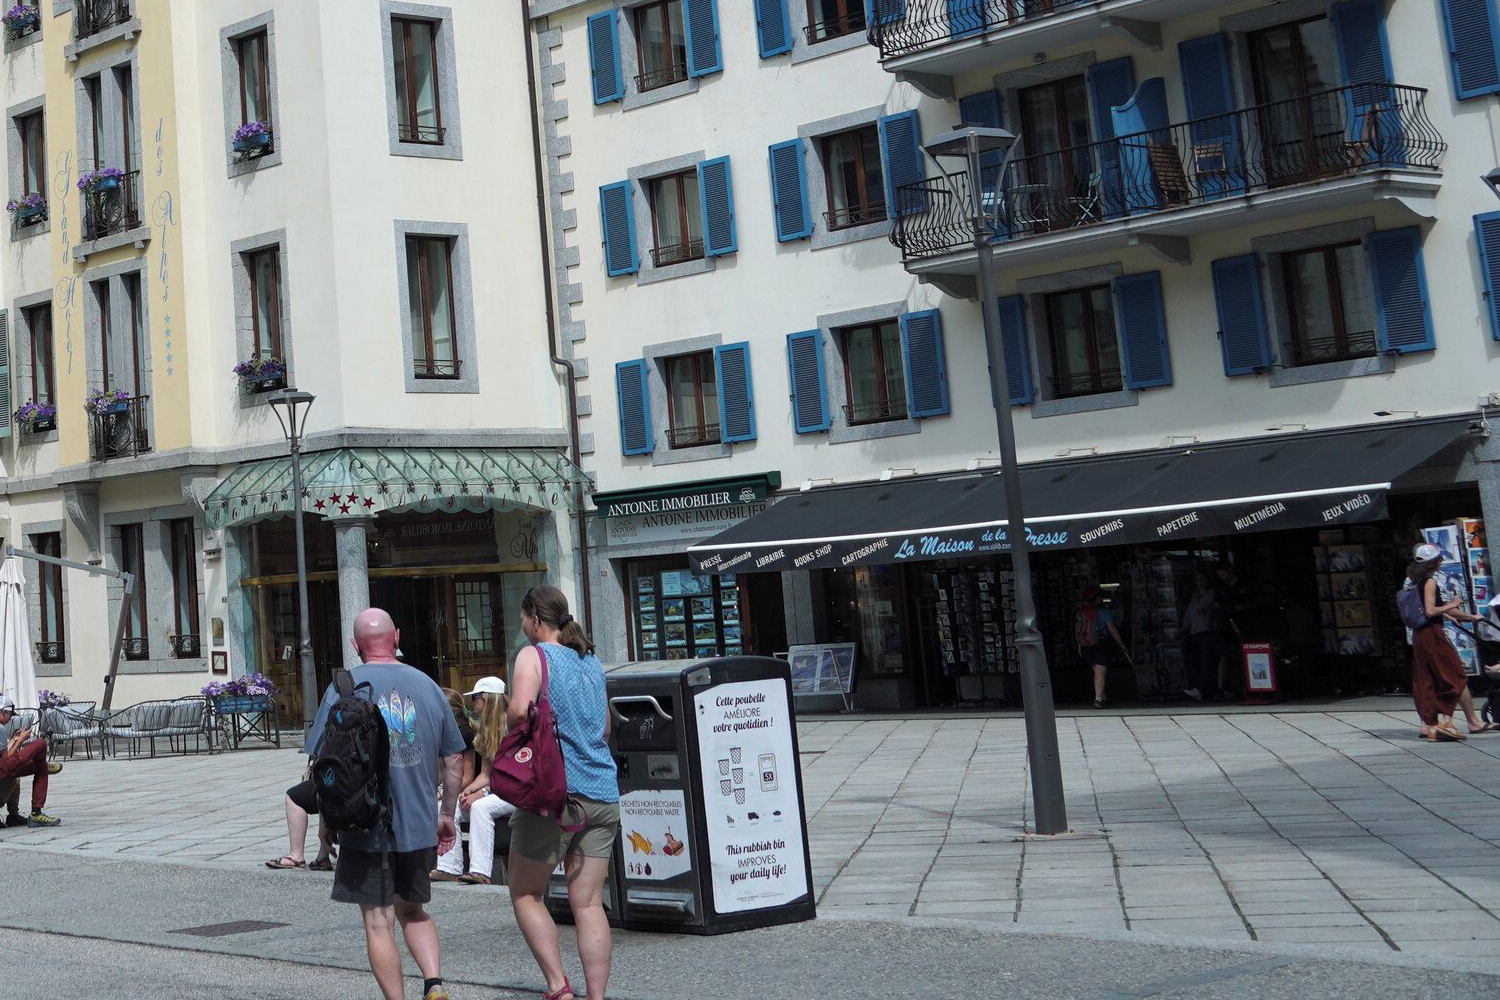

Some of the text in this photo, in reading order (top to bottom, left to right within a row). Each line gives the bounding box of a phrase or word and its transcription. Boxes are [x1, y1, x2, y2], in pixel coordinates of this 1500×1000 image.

[152, 117, 177, 303] des Alpes
[608, 491, 731, 517] ANTOINE IMMOBILIER
[1321, 493, 1371, 522] JEUX VIDÉO
[642, 503, 766, 528] ANTOINE IMMOBILIER
[1156, 511, 1200, 537] PAPETERIE
[1233, 502, 1286, 530] MULTIMÉDIA
[1080, 518, 1124, 544] SOUVENIRS
[841, 537, 889, 566] CARTOGRAPHIE
[894, 539, 916, 559] La
[920, 536, 975, 556] Maison
[981, 529, 994, 542] de
[995, 528, 1008, 541] la
[700, 554, 723, 571] PRESSE
[717, 551, 752, 571] internationale
[755, 549, 785, 568] LIBRAIRIE
[794, 544, 832, 568] BOOKS SHOP
[715, 693, 766, 708] Cette poubelle
[723, 707, 761, 720] AMÉLIORE
[713, 722, 732, 733] votre
[733, 718, 769, 733] quotidien
[621, 799, 640, 808] DÉCHETS
[653, 800, 682, 808] RECYCLABLES
[625, 808, 680, 816] NON RECYCLABLE WASTE
[726, 838, 785, 856] This rubbish bin
[737, 854, 777, 869] IMPROVES
[730, 864, 787, 885] your daily life!
